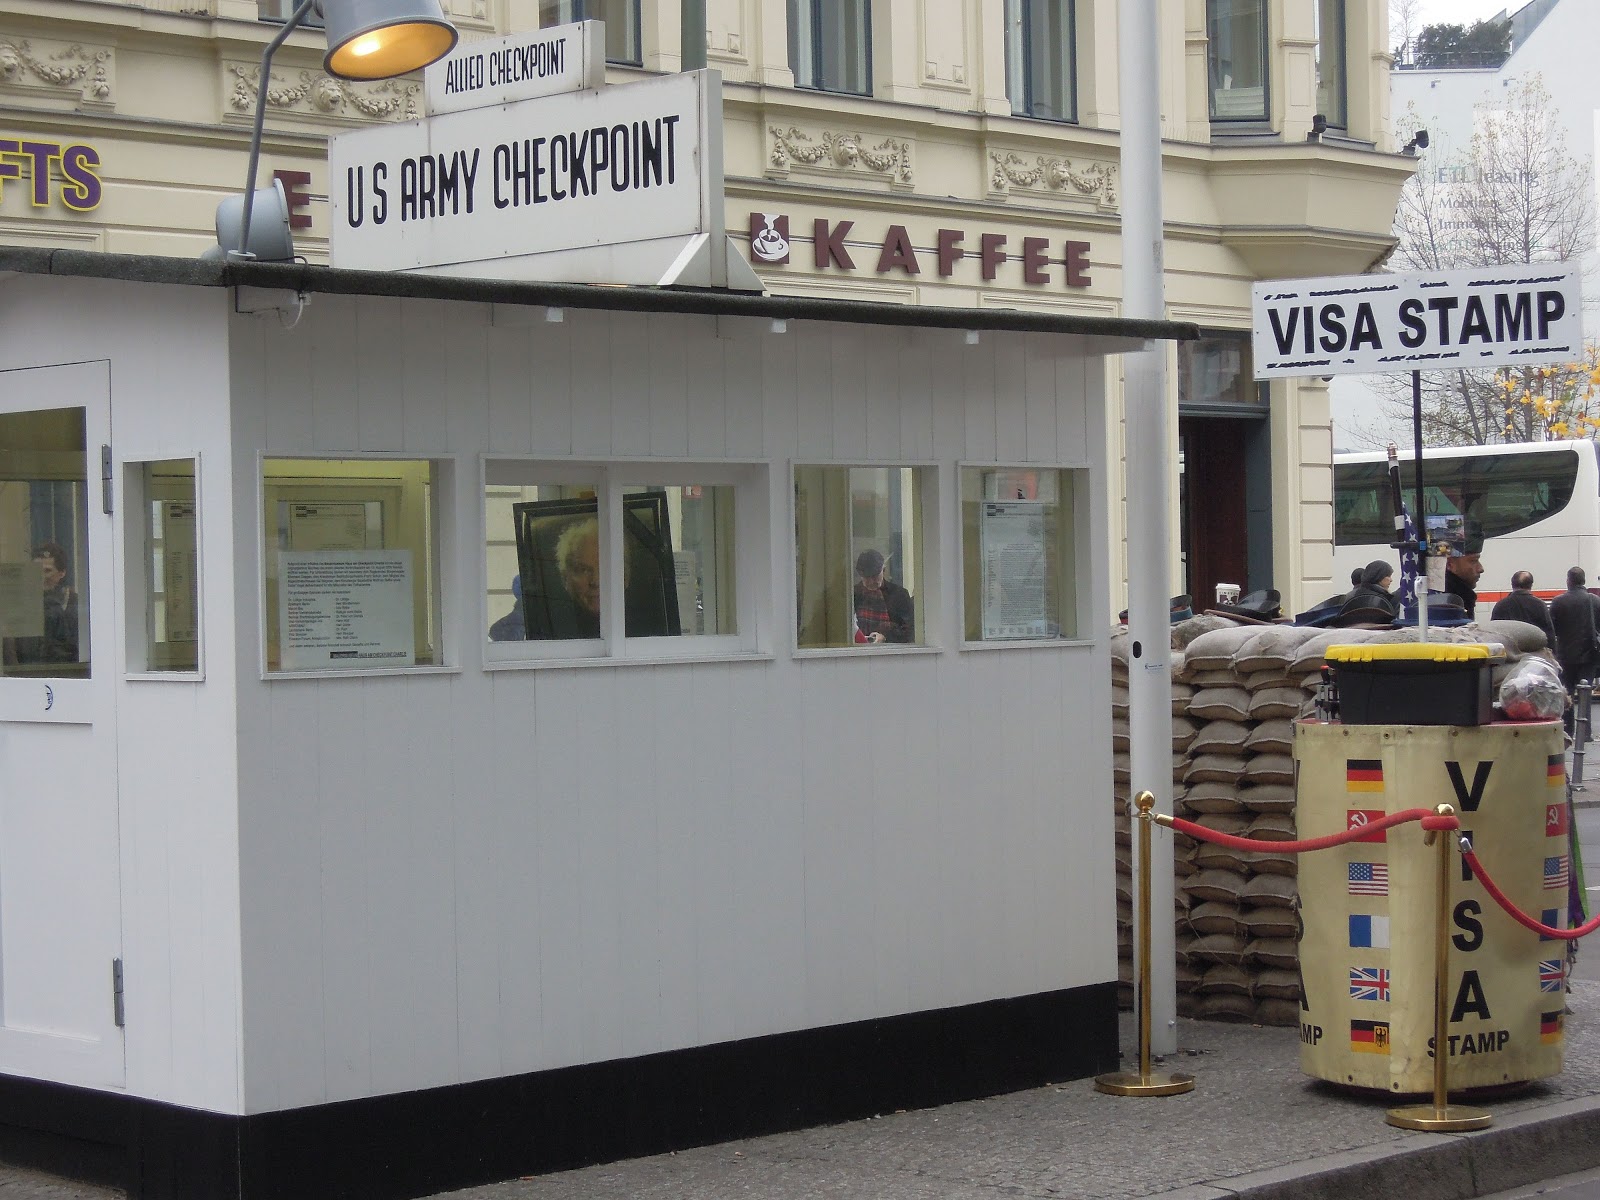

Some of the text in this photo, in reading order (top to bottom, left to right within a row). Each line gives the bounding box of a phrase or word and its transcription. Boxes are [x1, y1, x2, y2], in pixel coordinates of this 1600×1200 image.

[445, 38, 567, 95] ALLIED CHECKPOINT
[347, 114, 680, 228] U S ARMY CHECKPOINT
[814, 218, 1092, 287] KAFFEE
[1267, 290, 1566, 356] VISA STAMP
[1301, 1023, 1323, 1045] MP
